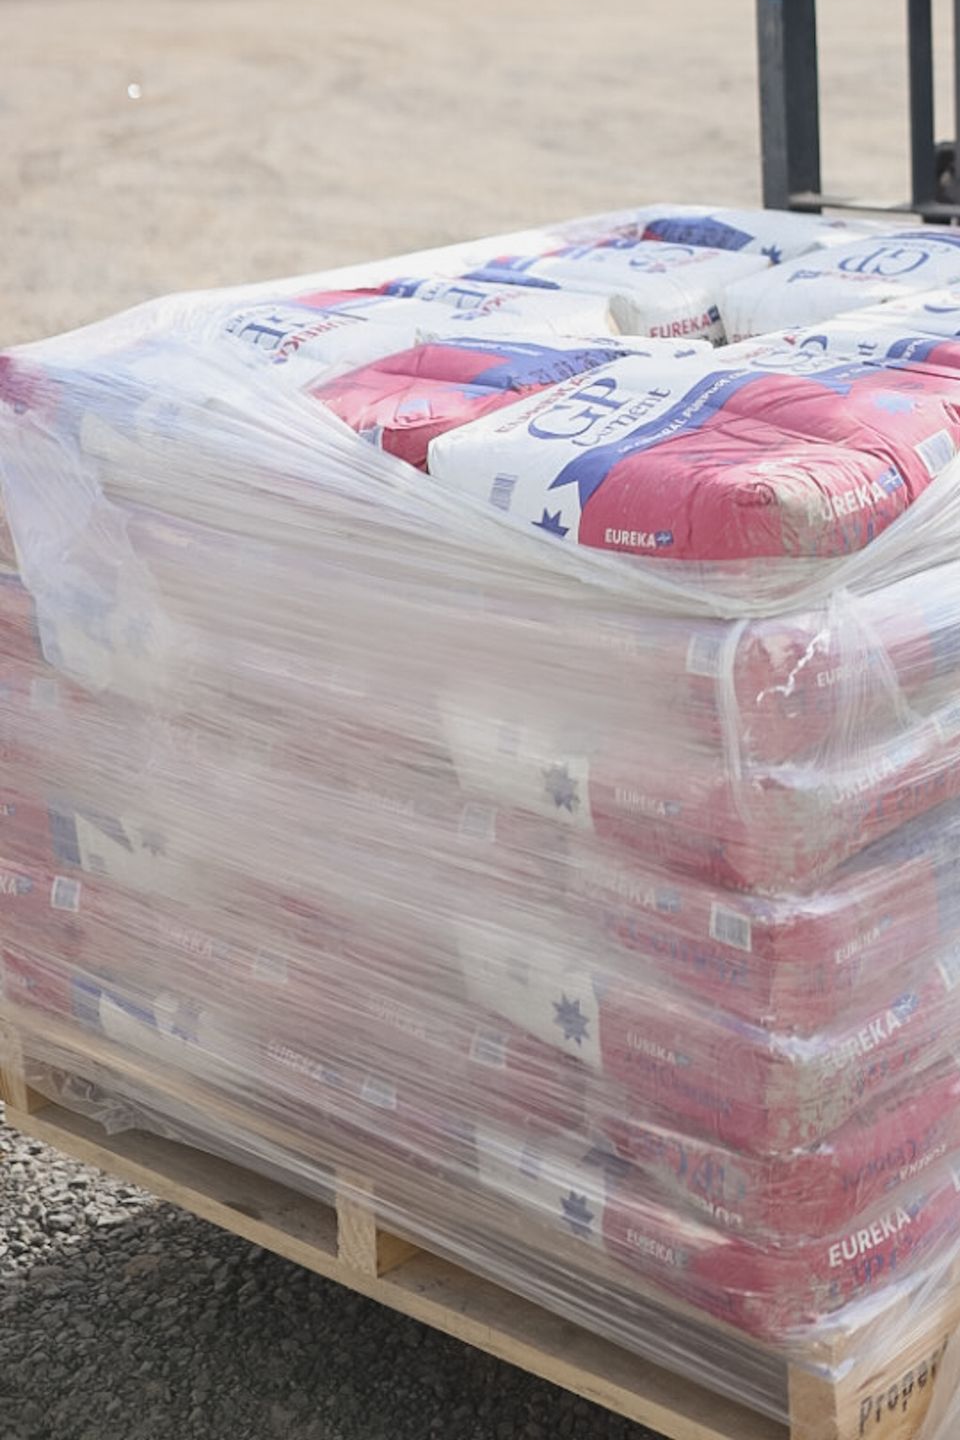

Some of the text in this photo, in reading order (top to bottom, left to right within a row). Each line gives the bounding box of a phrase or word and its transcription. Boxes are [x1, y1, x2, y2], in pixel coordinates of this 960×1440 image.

[528, 378, 634, 440] GP
[604, 527, 656, 548] EUREKA
[828, 1207, 912, 1268] EUREKA
